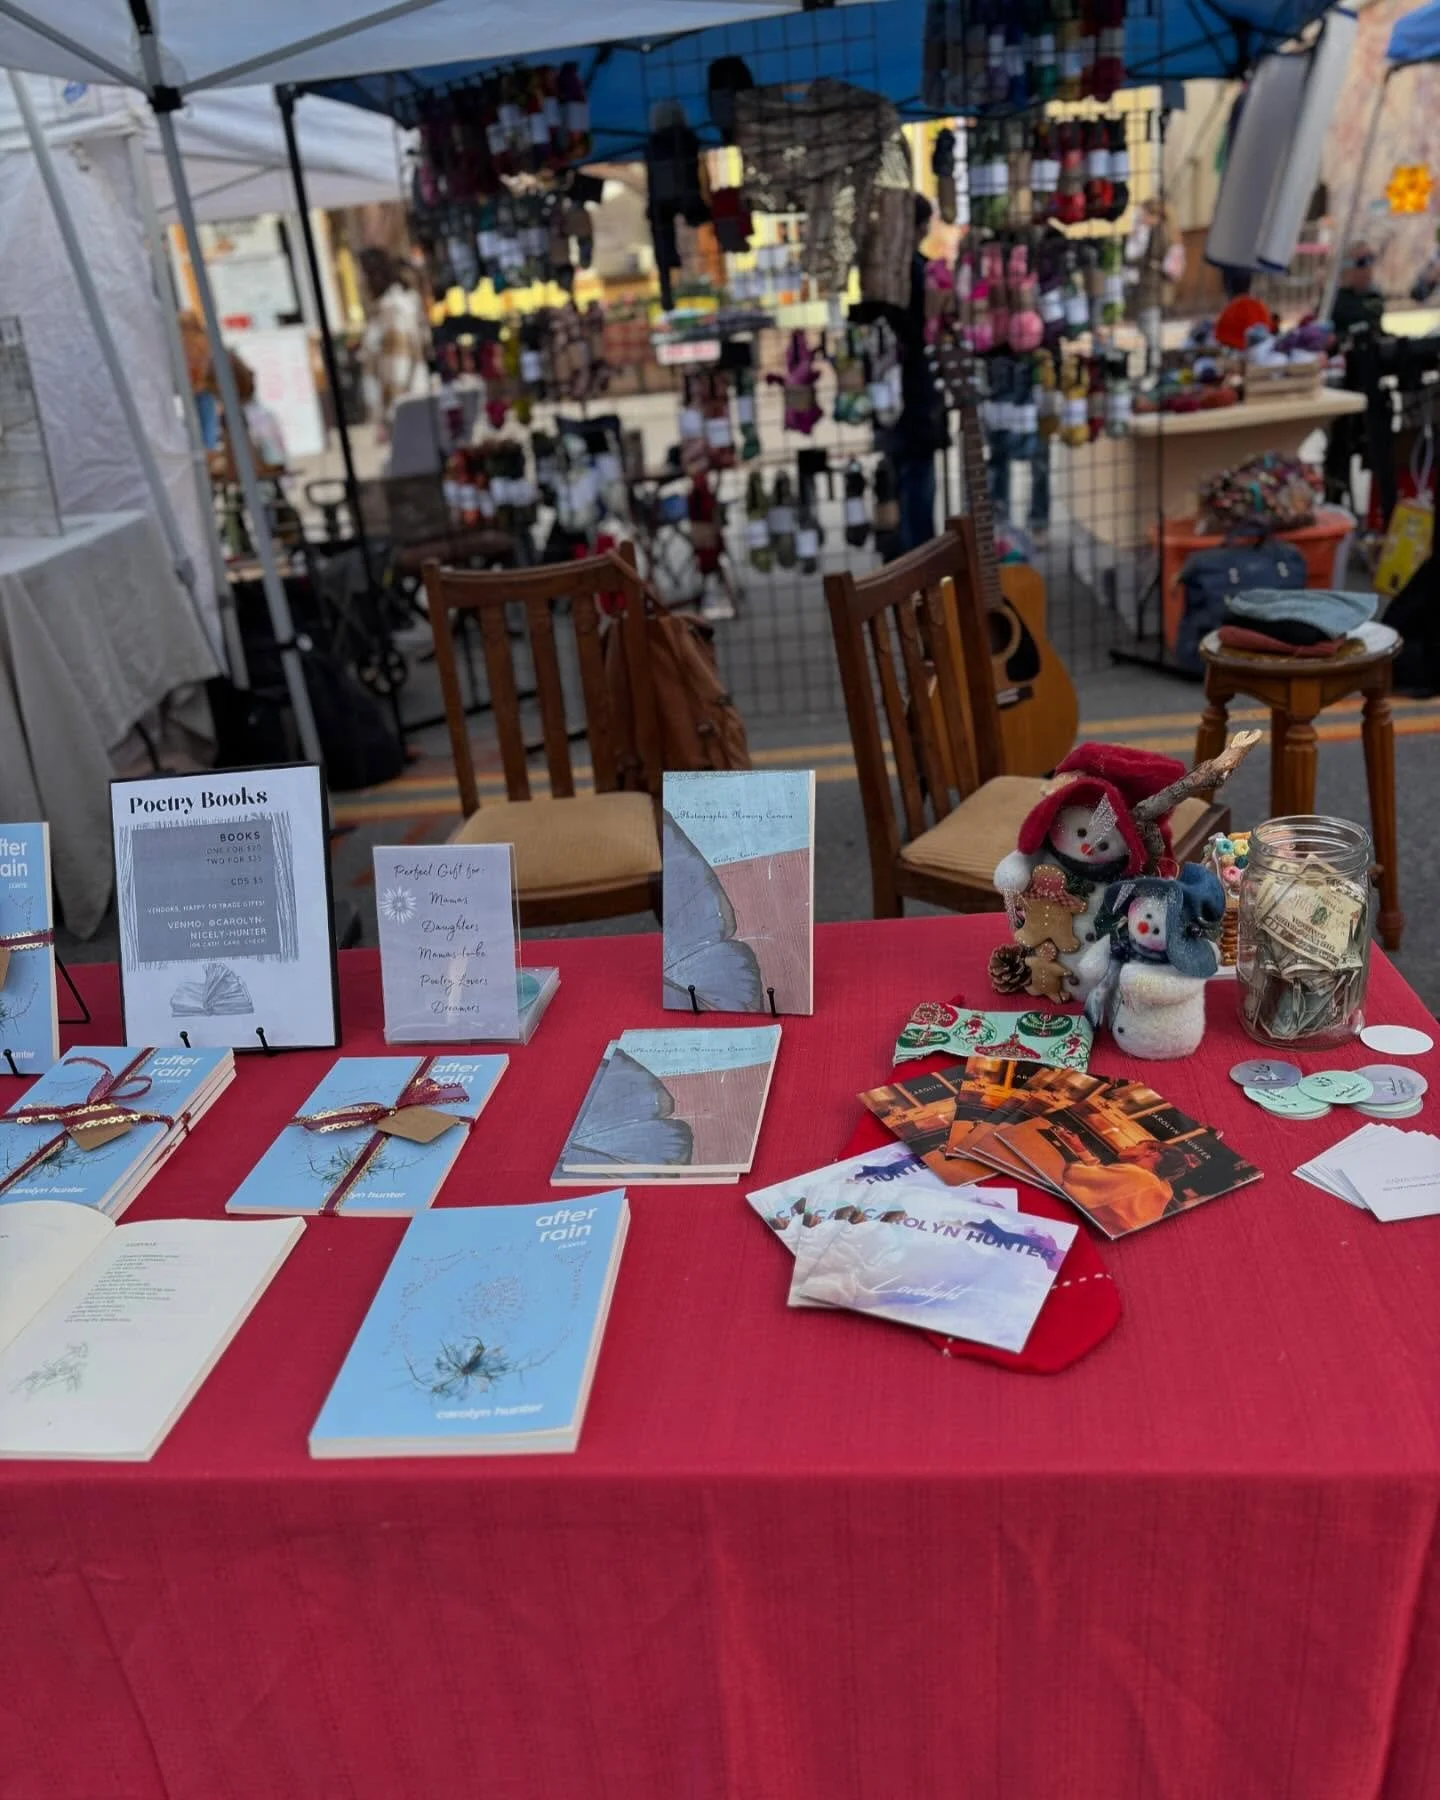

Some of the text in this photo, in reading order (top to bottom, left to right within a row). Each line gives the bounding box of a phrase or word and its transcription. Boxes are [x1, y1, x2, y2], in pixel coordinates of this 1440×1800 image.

[129, 786, 268, 815] Poetry Books
[765, 811, 793, 819] Camera
[219, 831, 261, 842] BOOKS
[0, 837, 28, 856] fter
[0, 857, 28, 877] ain
[393, 864, 433, 880] Perfect
[437, 863, 463, 880] Gift
[429, 891, 469, 906] Mamas
[421, 914, 480, 942] Daughters
[420, 973, 488, 996] Poetry Lovers
[430, 1000, 481, 1014] Dreamers
[153, 1055, 204, 1066] after
[432, 1062, 482, 1073] after
[535, 1207, 599, 1228] after
[539, 1223, 593, 1244] rain
[965, 1229, 1057, 1263] HUNTER
[494, 1403, 544, 1417] hunter
